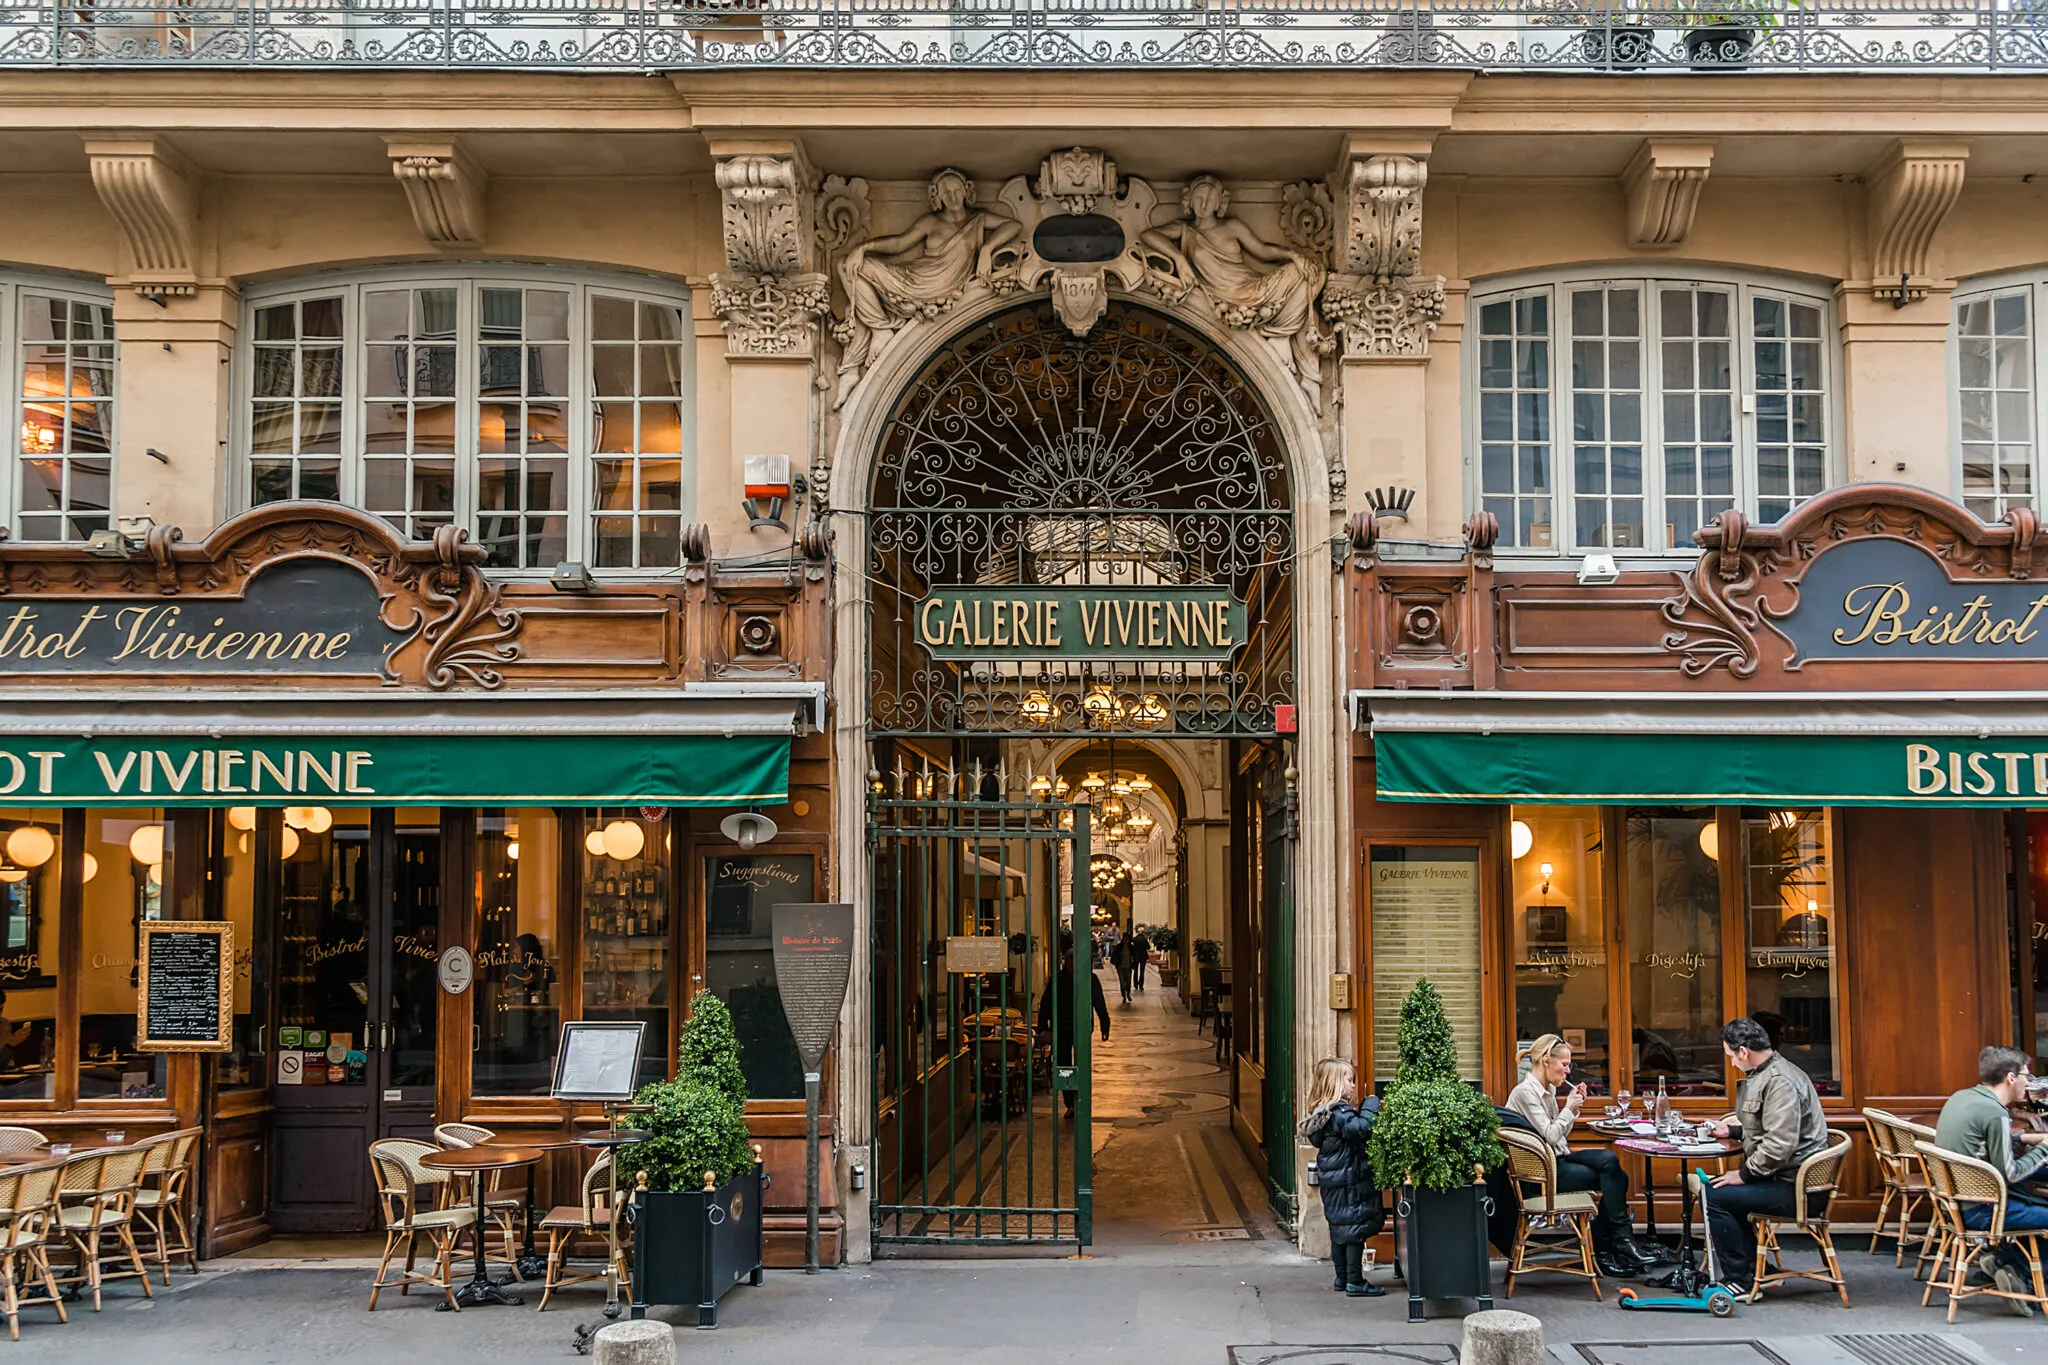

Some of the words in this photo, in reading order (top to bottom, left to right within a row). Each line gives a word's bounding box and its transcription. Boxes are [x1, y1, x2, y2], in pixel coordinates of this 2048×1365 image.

[1064, 283, 1095, 297] 1844
[921, 598, 1062, 646] GALERIE
[1079, 599, 1233, 647] VIVIENNE
[1833, 581, 2048, 645] Bistrot
[113, 605, 351, 661] Vivienne
[94, 750, 375, 794] VIVIENNE
[719, 862, 800, 884] Suggestions
[305, 936, 369, 967] Bistrot
[478, 949, 509, 969] Plat
[1645, 952, 1706, 972] Digestifs
[1756, 950, 1829, 972] Champagne
